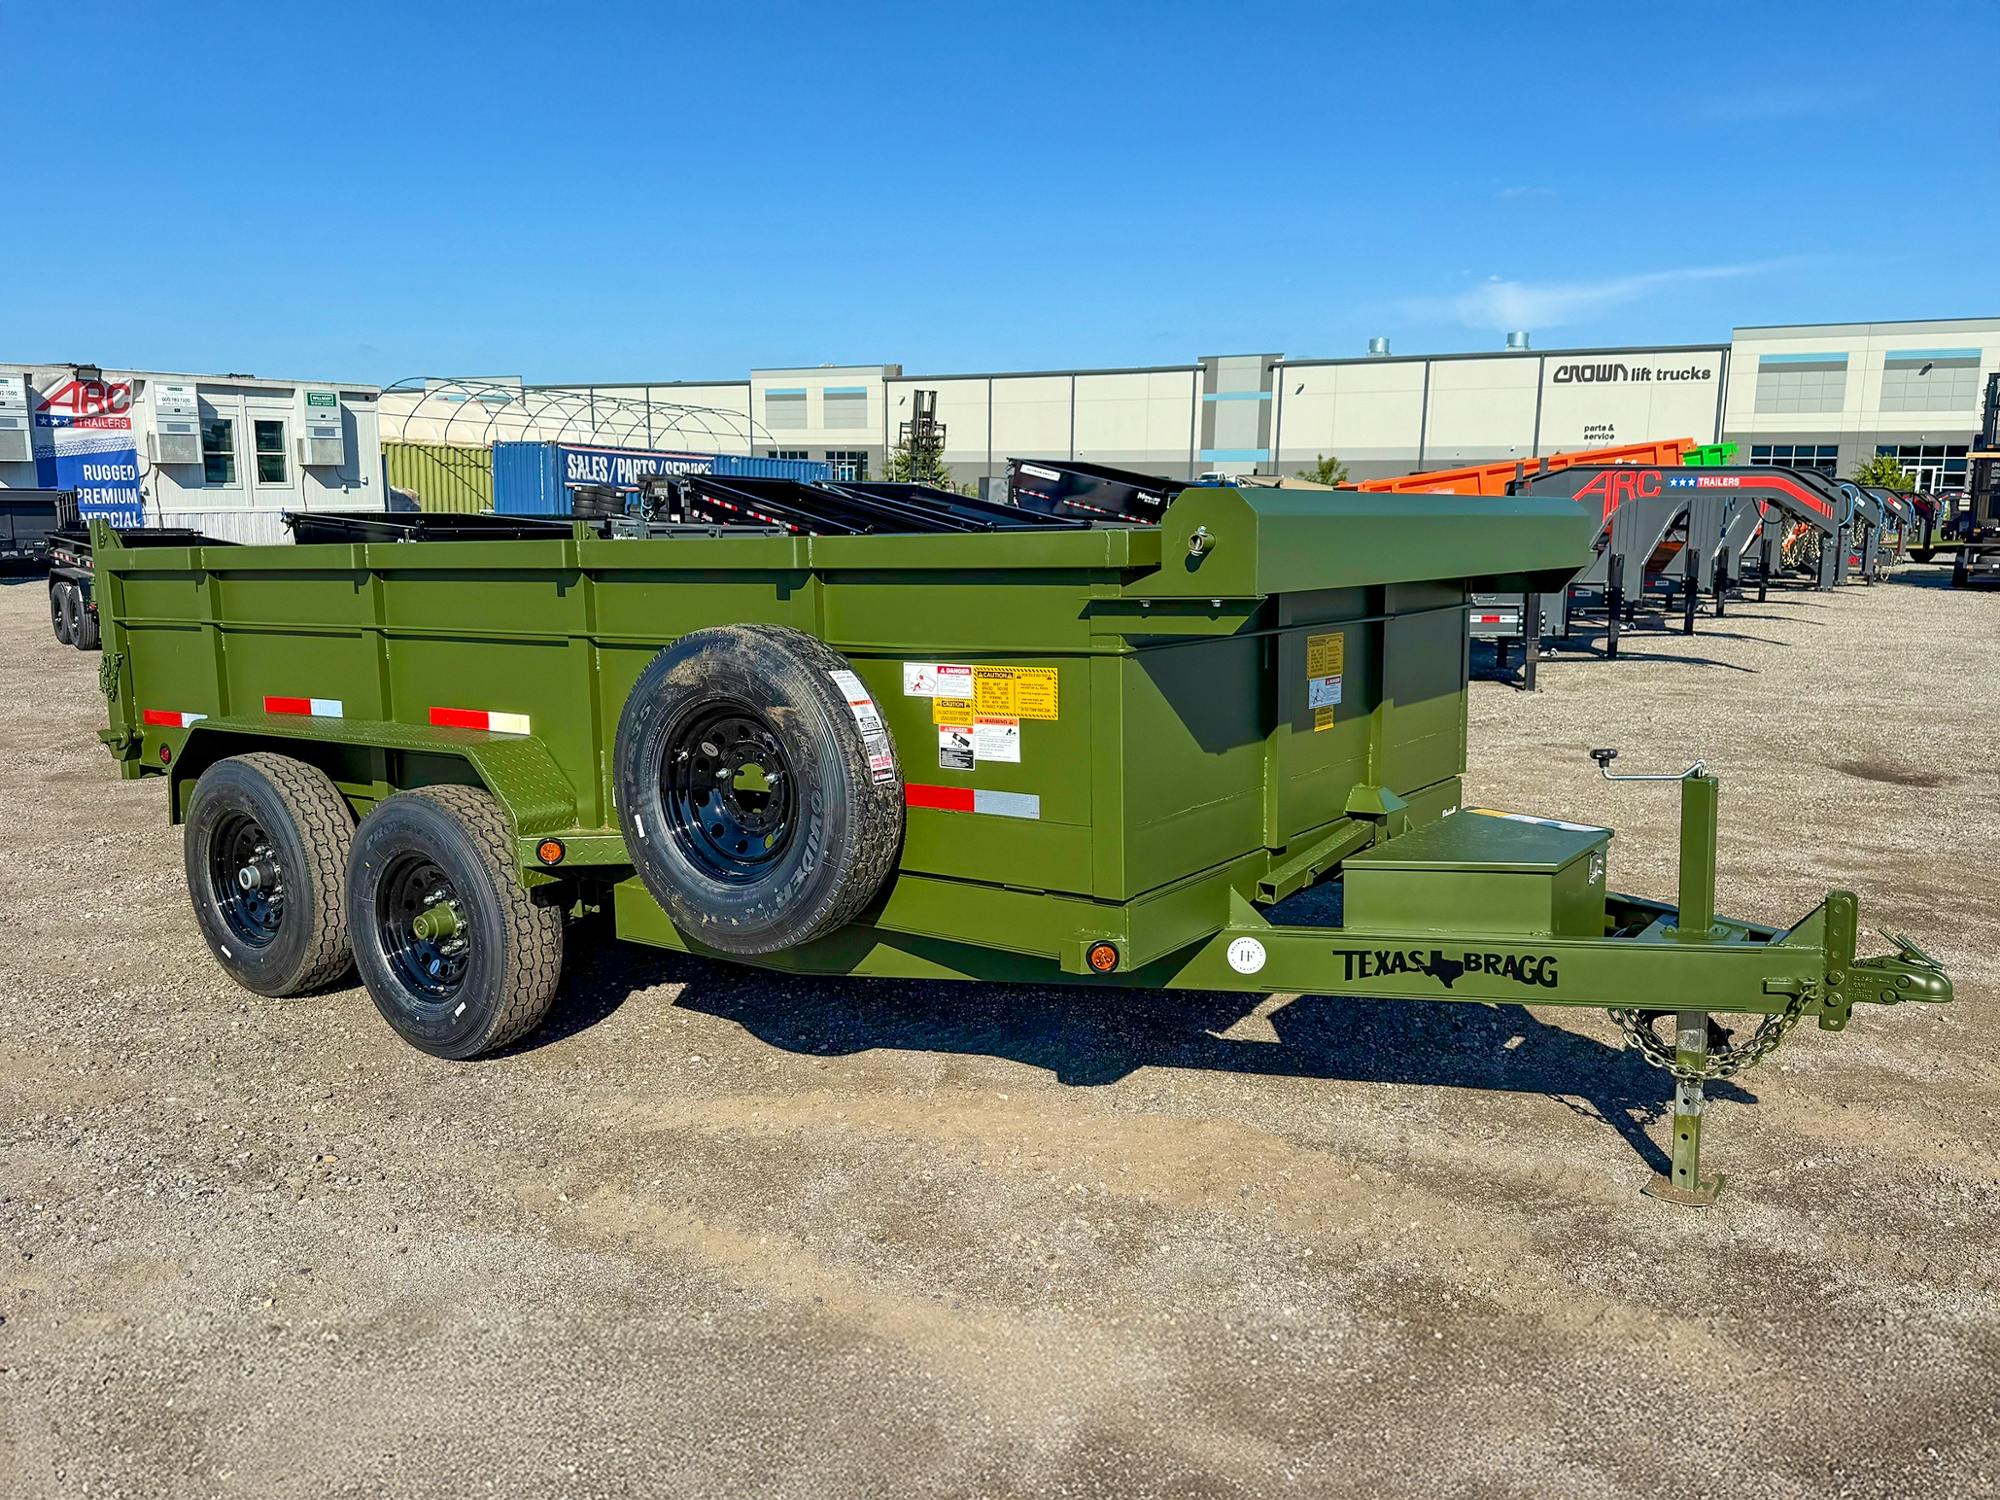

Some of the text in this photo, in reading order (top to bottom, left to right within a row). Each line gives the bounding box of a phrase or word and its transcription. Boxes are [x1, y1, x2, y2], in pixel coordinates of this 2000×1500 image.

[1553, 364, 1711, 383] CROWN lift trucks
[35, 381, 131, 414] ARC
[78, 417, 128, 428] TRAILERS
[1584, 425, 1606, 433] parts
[1584, 432, 1615, 440] service
[83, 464, 136, 481] RUGGED
[77, 487, 138, 505] PREMIUM
[1572, 470, 1740, 523] ARC TRAILERS
[946, 667, 970, 675] DANGER
[1332, 950, 1558, 988] TEXAS BRAGG
